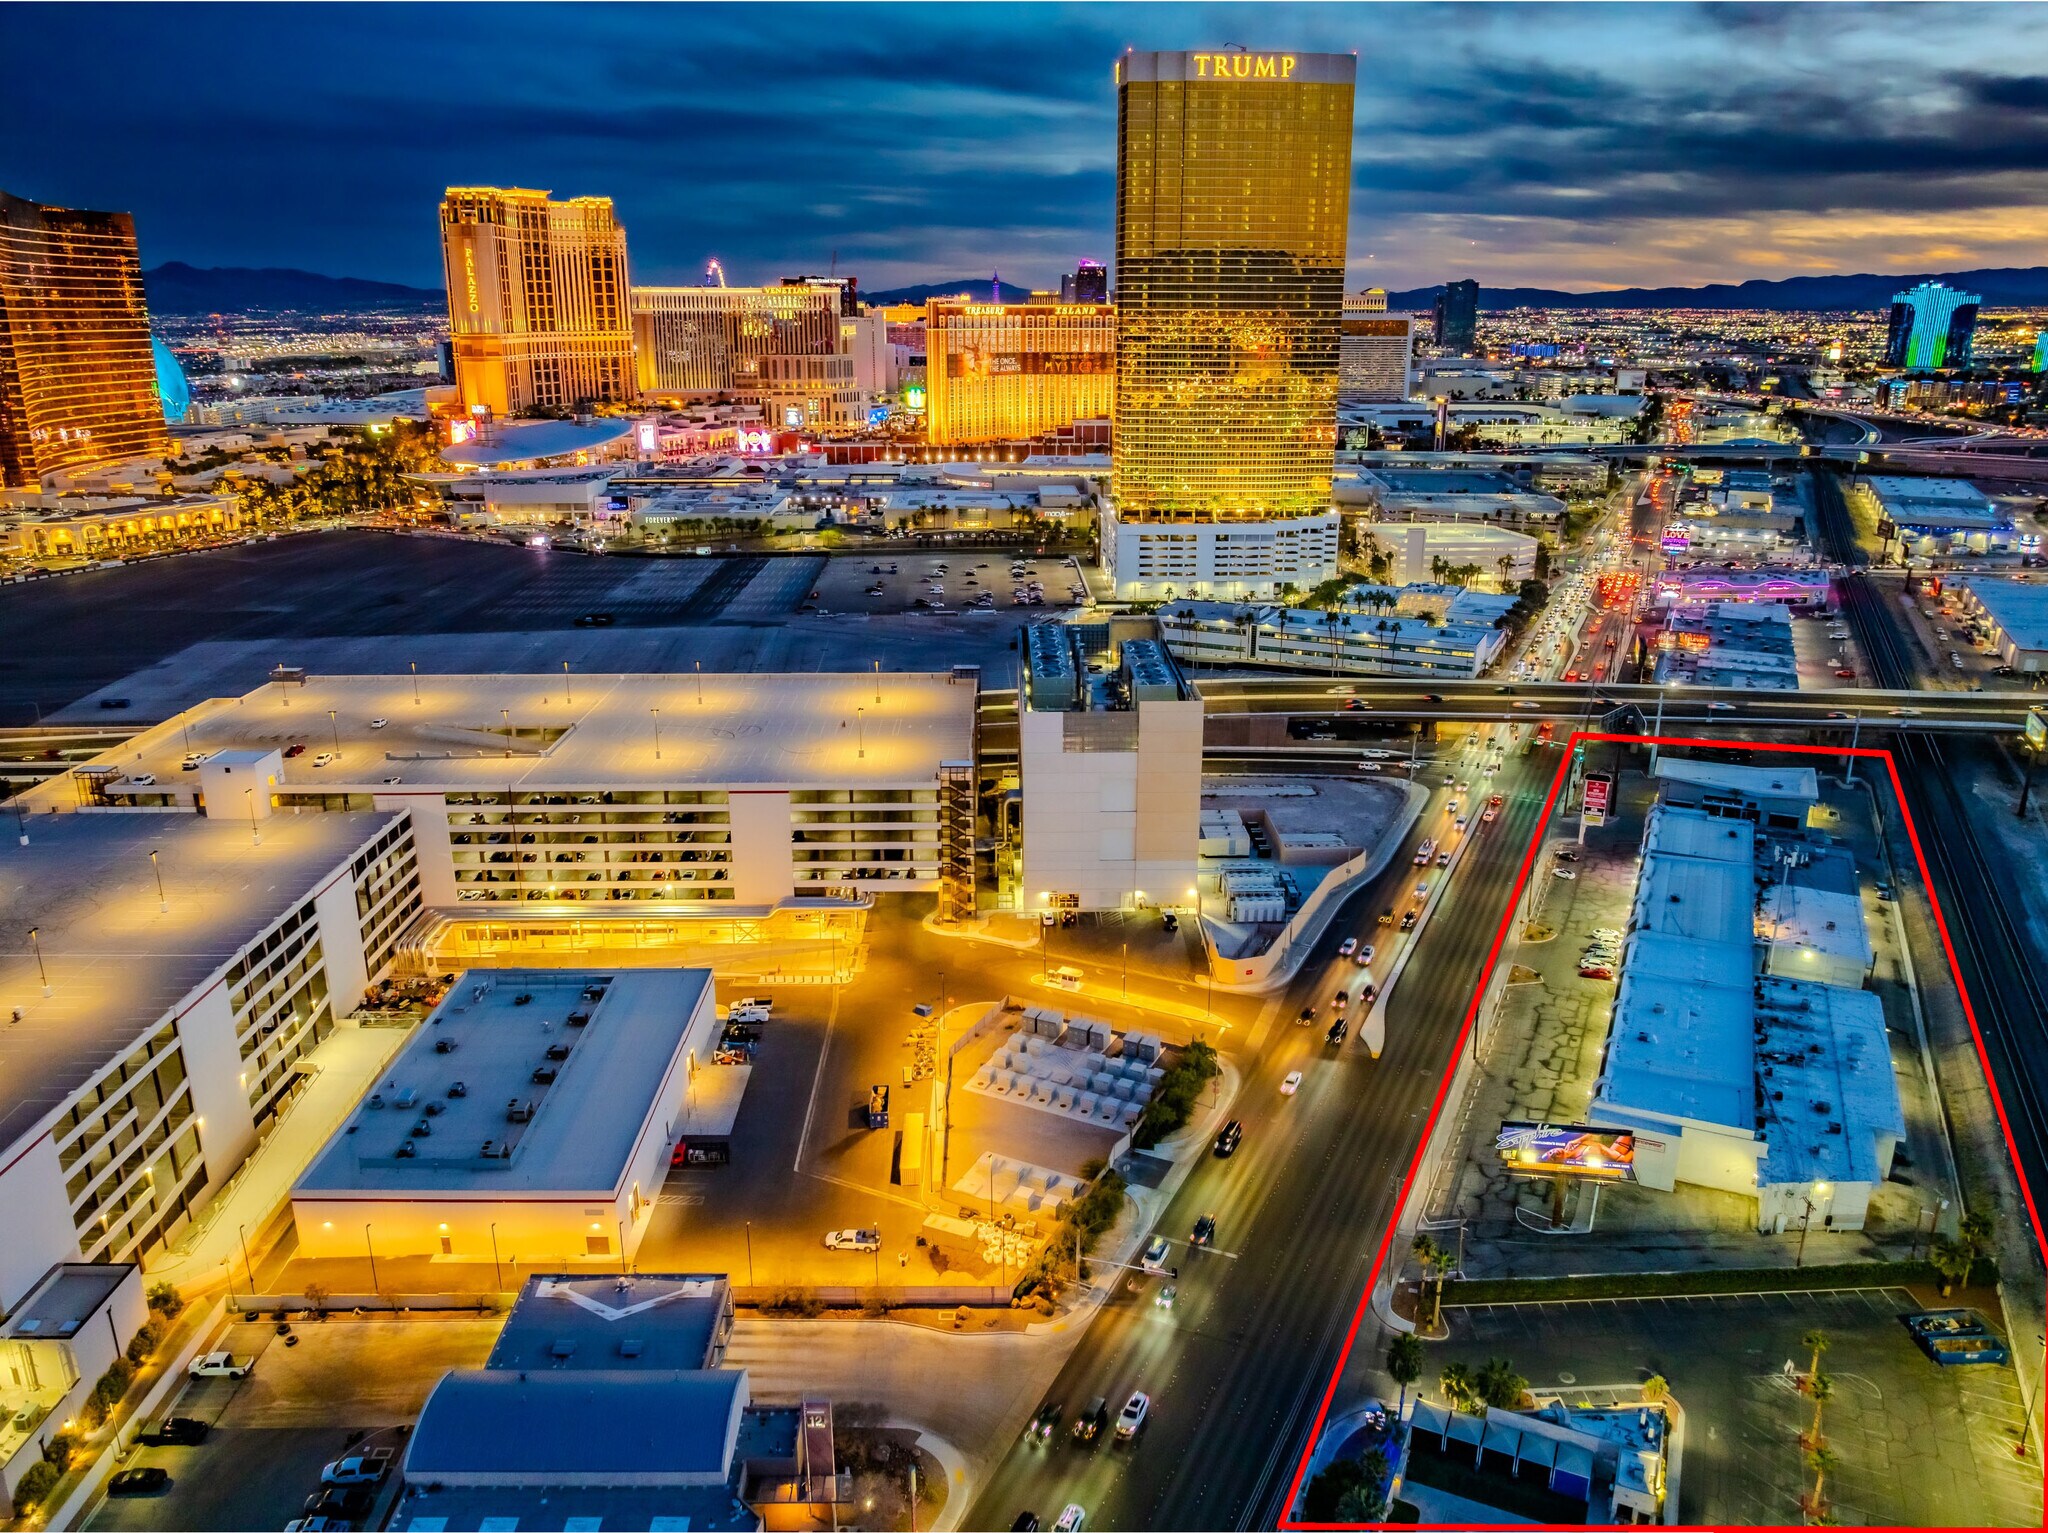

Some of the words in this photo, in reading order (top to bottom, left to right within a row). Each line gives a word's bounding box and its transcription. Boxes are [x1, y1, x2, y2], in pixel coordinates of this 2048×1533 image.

[1193, 55, 1296, 78] TRUMP
[465, 248, 478, 312] PALAZZO
[764, 286, 810, 294] VENETIAN
[965, 306, 1005, 316] TREASURE
[1055, 306, 1096, 315] ISLAND
[1664, 531, 1690, 539] LOVE
[1495, 1122, 1567, 1151] Sapphire
[810, 1415, 823, 1428] 12
